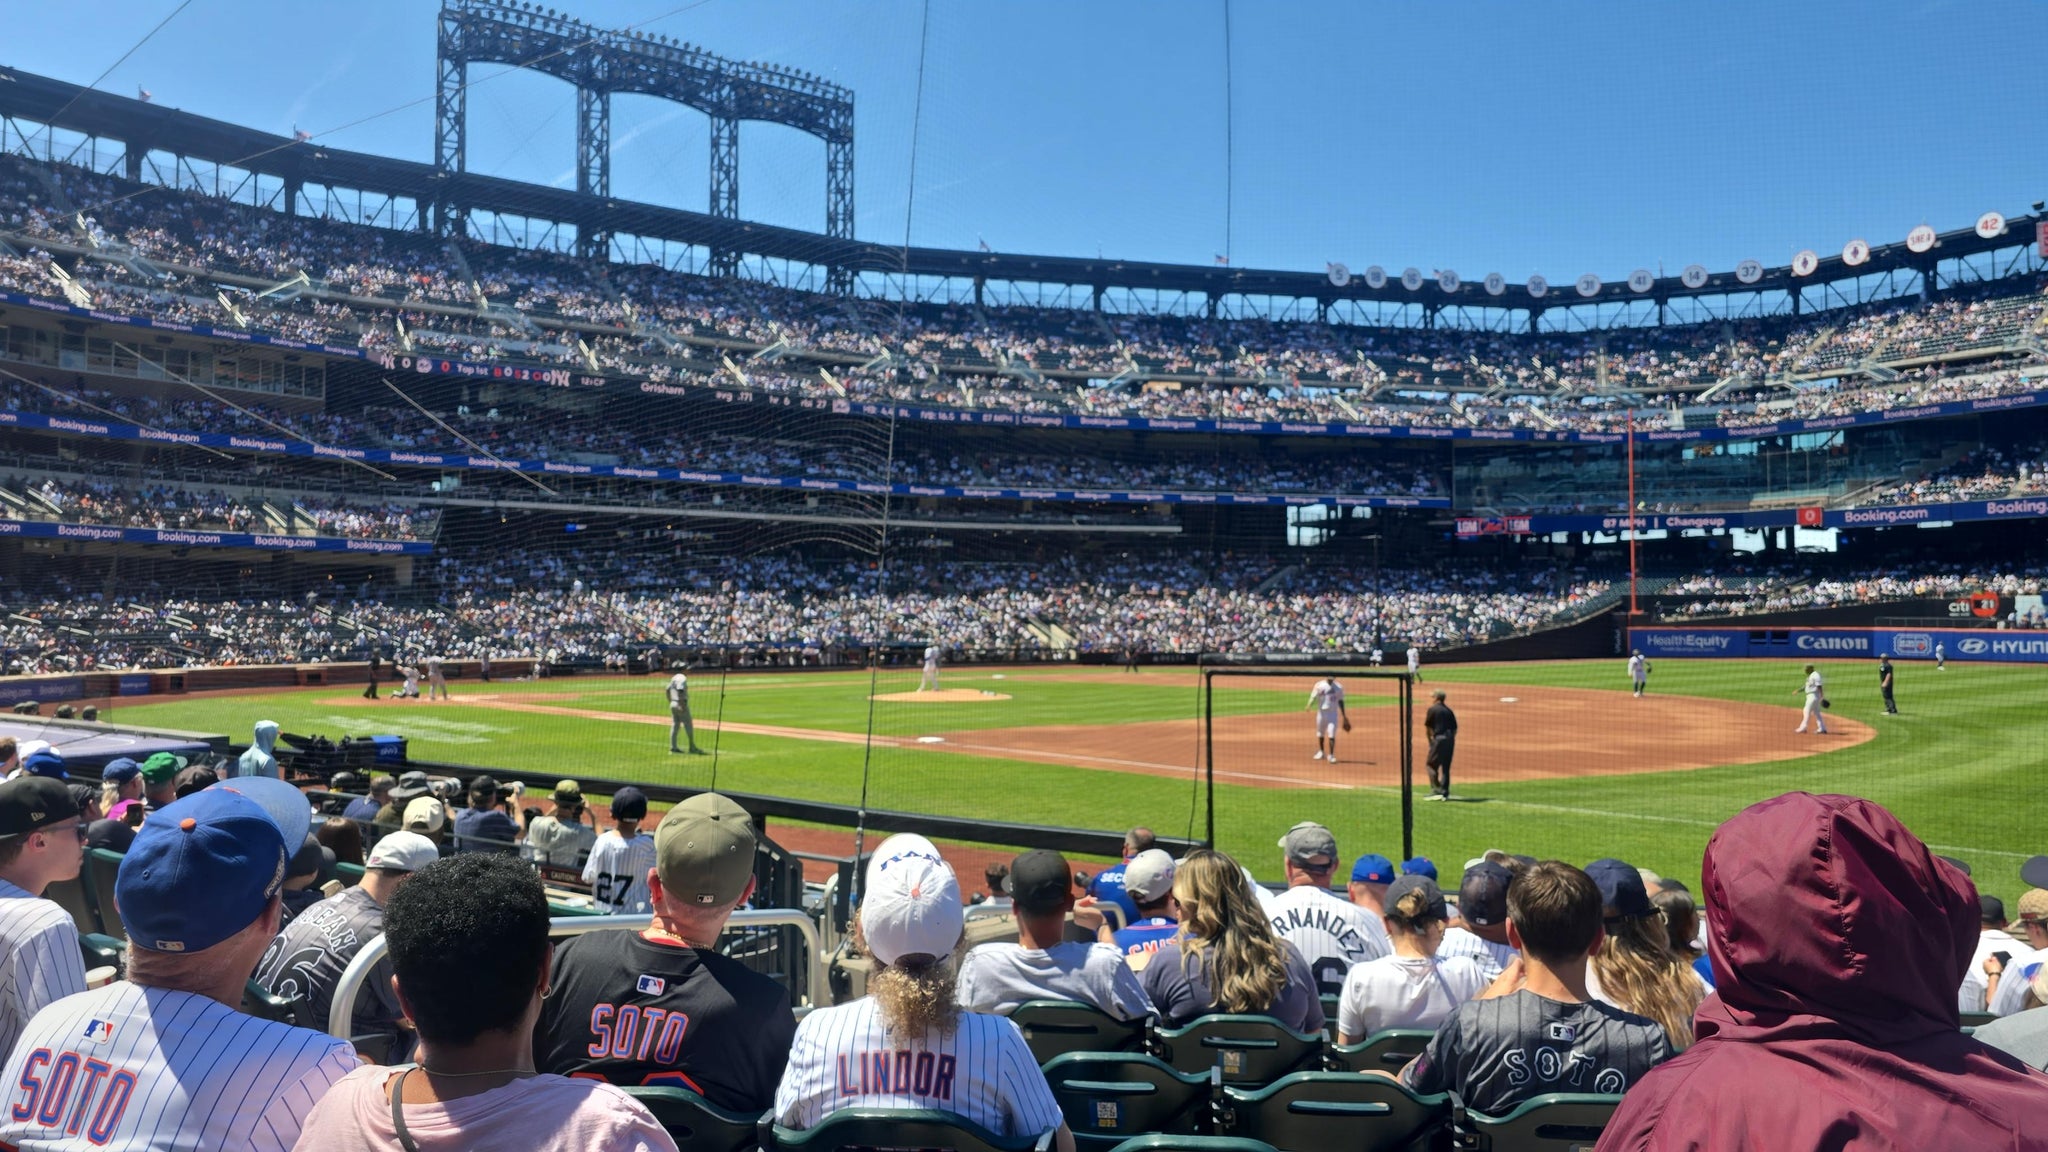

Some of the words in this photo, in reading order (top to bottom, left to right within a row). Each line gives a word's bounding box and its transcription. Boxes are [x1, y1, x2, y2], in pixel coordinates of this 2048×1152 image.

[1981, 218, 1999, 231] 42
[1689, 271, 1700, 281] 14
[1741, 266, 1757, 277] 37
[1635, 275, 1647, 286] 41
[401, 357, 411, 369] 0
[456, 363, 474, 375] Top
[522, 370, 530, 380] 2
[641, 382, 685, 396] Grisham
[716, 391, 733, 403] avg
[1972, 394, 2036, 409] Booking.com
[816, 400, 827, 409] 27
[1883, 406, 1941, 420] Booking.com
[49, 418, 108, 434] Booking.com
[139, 428, 200, 443] Booking.com
[230, 436, 286, 451] Booking.com
[313, 445, 365, 459] Booking.com
[390, 452, 443, 464] Booking.com
[1845, 508, 1928, 523] Booking.com
[1457, 520, 1478, 533] LGM
[1509, 519, 1530, 532] LGM
[1603, 518, 1616, 528] 87
[1665, 517, 1726, 528] Changeup
[157, 531, 220, 544] Booking.com
[255, 536, 316, 548] Booking.com
[347, 540, 403, 551] Booking.com
[1949, 601, 1970, 613] citi
[1647, 634, 1730, 648] HealthEquity
[1797, 635, 1868, 650] Canon
[597, 872, 634, 905] 27
[1271, 908, 1364, 960] RNANDEZ
[588, 1003, 689, 1065] SOTO
[839, 1049, 957, 1101] LINDOR
[1503, 1046, 1626, 1094] SOTO
[12, 1048, 137, 1146] SOTO
